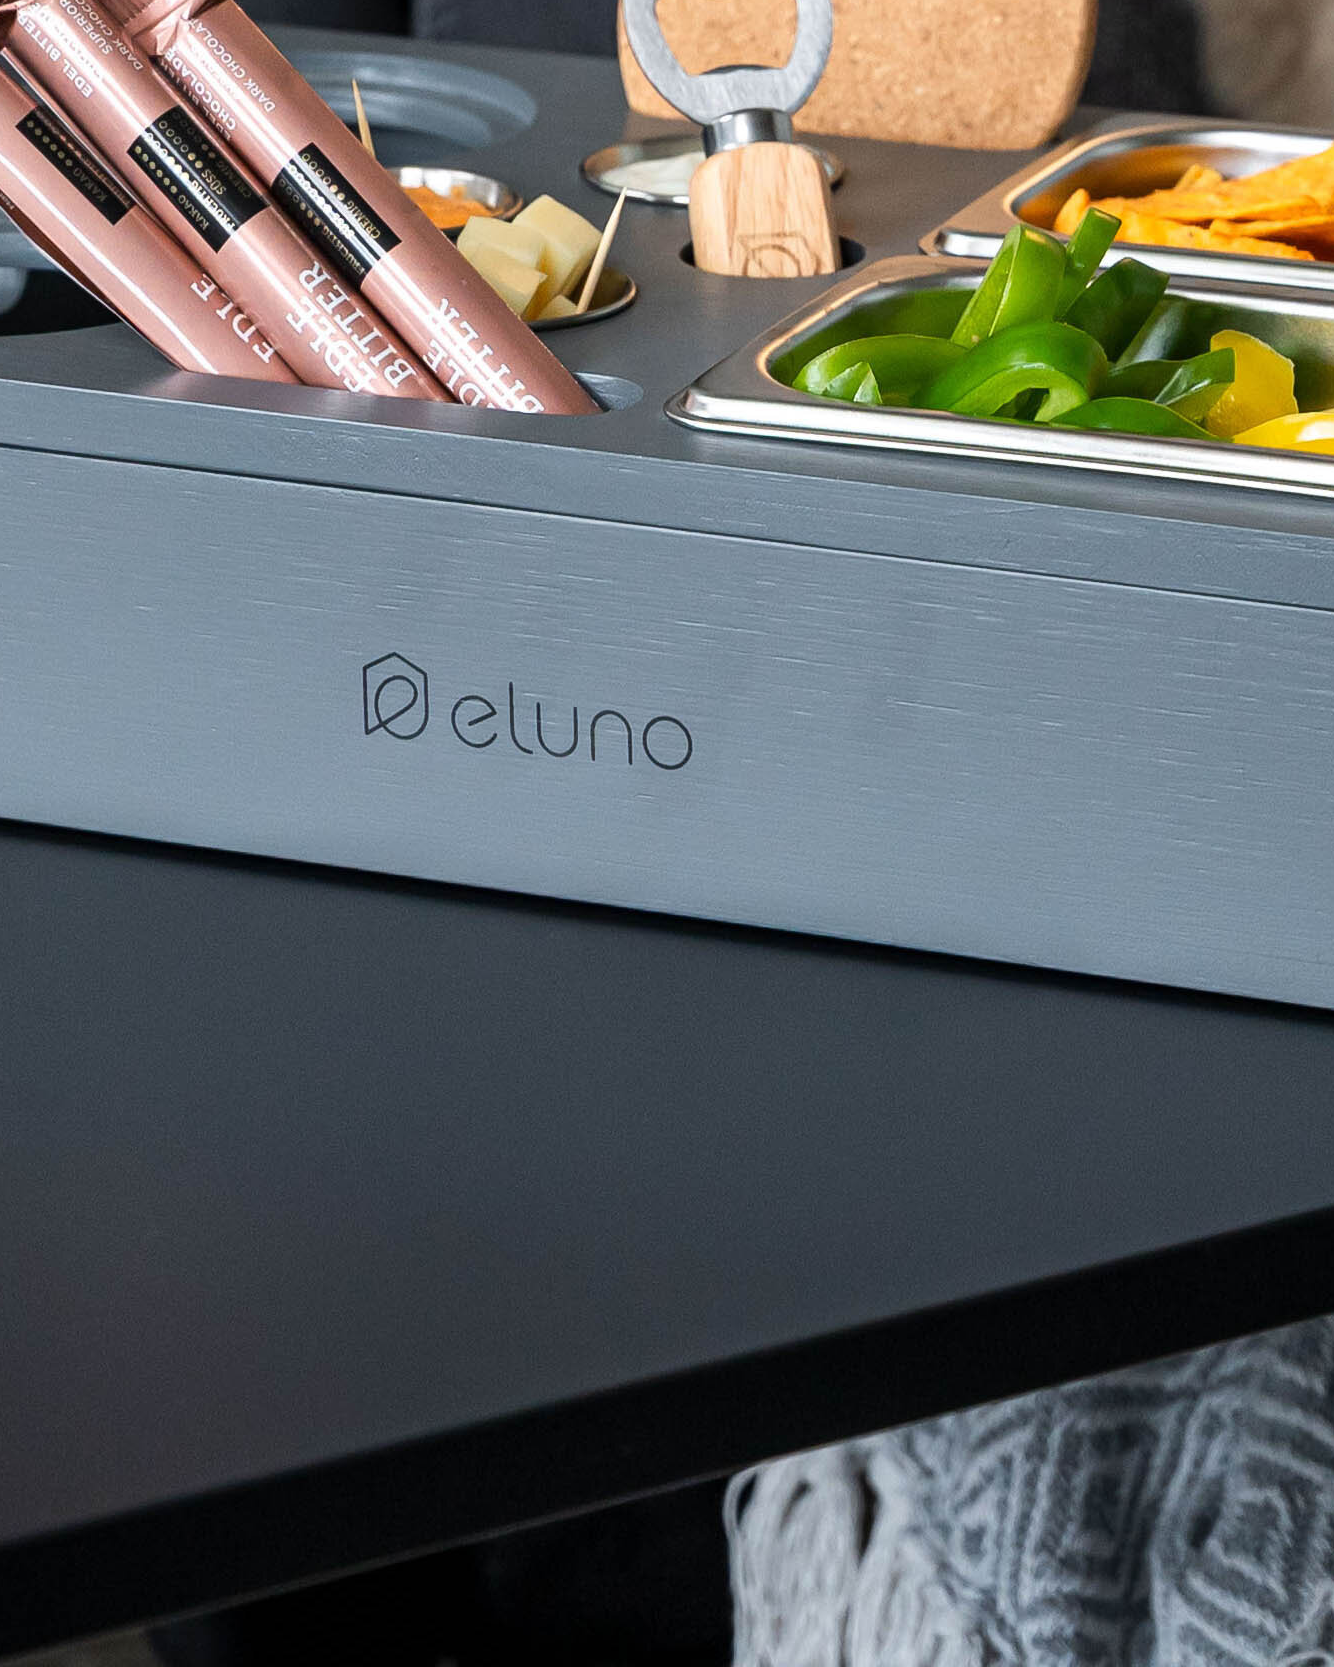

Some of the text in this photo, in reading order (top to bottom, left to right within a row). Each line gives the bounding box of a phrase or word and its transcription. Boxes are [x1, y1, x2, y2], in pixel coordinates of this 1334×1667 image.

[62, 57, 93, 98] EDEL
[112, 38, 144, 71] DARK
[164, 45, 236, 131] CHOCOLADE
[243, 79, 276, 112] DARK
[73, 168, 108, 202] KAKAO
[178, 195, 210, 231] KAKAO
[347, 200, 381, 239] CREMIG
[190, 274, 275, 363] EDLE
[285, 296, 376, 393] EDLE
[299, 261, 417, 388] BITTER
[422, 339, 494, 409] DLE
[451, 682, 693, 770] eluno
